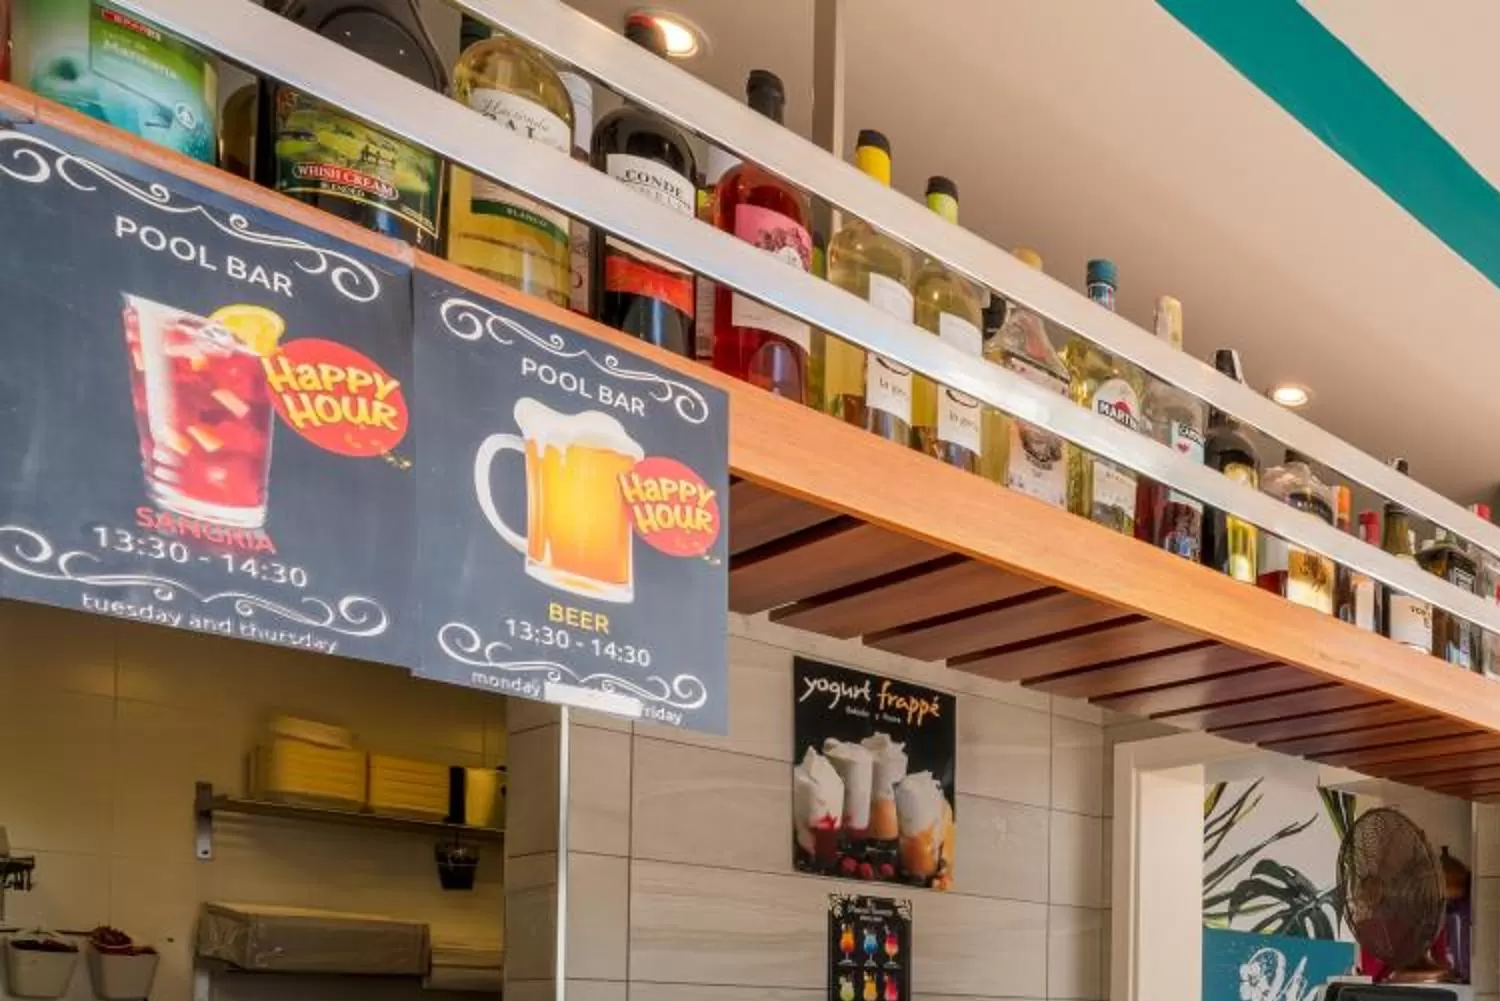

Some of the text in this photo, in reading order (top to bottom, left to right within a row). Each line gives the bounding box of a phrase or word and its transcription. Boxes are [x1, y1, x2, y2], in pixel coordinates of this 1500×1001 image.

[624, 169, 681, 197] CONDE
[114, 214, 294, 298] POOL BAR
[280, 392, 400, 431] HOUR
[520, 357, 646, 417] POOL BAR
[135, 506, 278, 556] SANGRIA
[631, 502, 715, 534] HOUR
[93, 525, 189, 564] 13:30
[220, 553, 309, 588] 14:30
[82, 592, 339, 655] tuesday and thursday
[505, 618, 570, 649] 13:30
[591, 638, 651, 668] 14:30
[548, 603, 610, 636] BEER
[471, 671, 543, 698] monday
[799, 677, 871, 709] yogurt
[877, 680, 940, 726] frappé
[642, 703, 684, 726] riday
